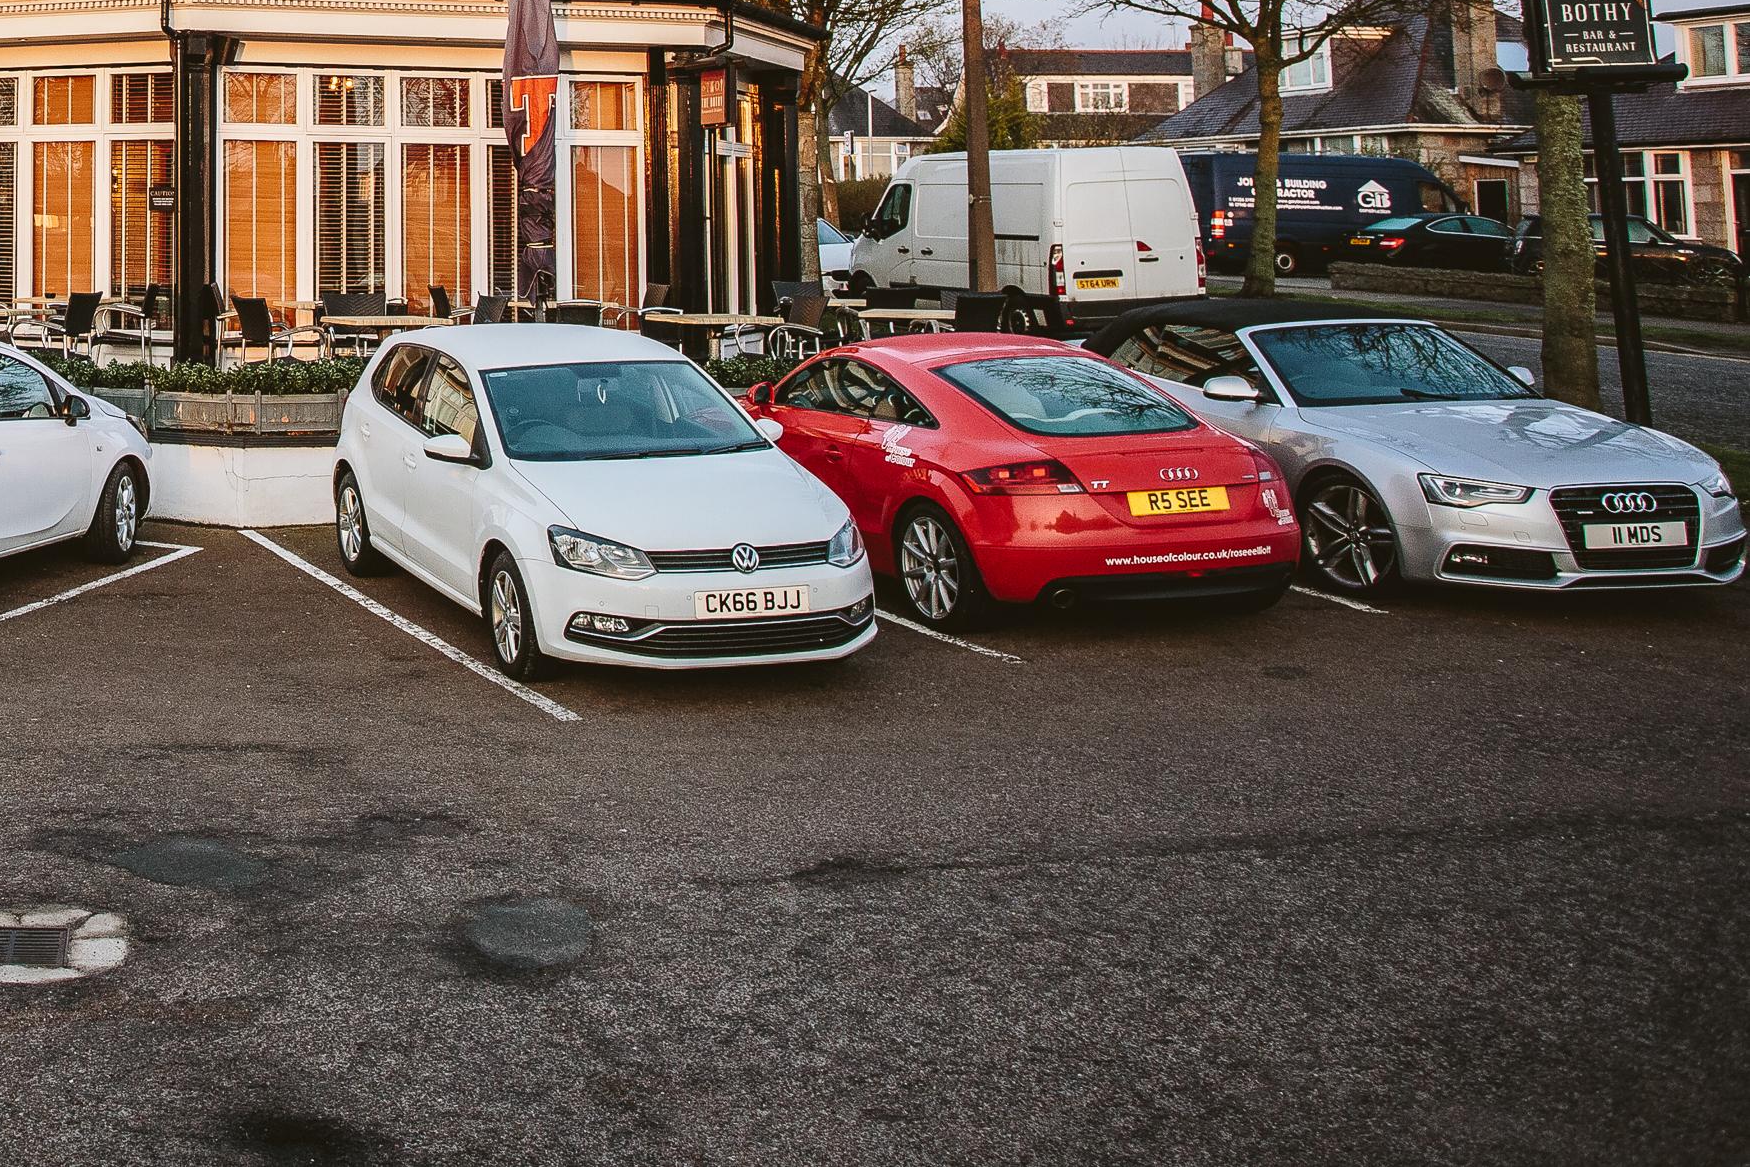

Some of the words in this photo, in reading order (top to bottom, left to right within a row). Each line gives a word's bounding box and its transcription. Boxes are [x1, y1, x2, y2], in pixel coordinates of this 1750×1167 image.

[1561, 2, 1632, 22] BOTHY
[1582, 30, 1604, 40] BAR
[1608, 30, 1616, 39] &
[1565, 42, 1636, 53] RESTAURANT
[1284, 179, 1327, 189] BUILDING
[1091, 480, 1110, 488] TT
[1148, 492, 1171, 510] R5
[1175, 489, 1211, 509] SEE
[1627, 525, 1662, 544] MDS
[705, 592, 758, 613] CK66
[763, 590, 801, 611] BJJ
